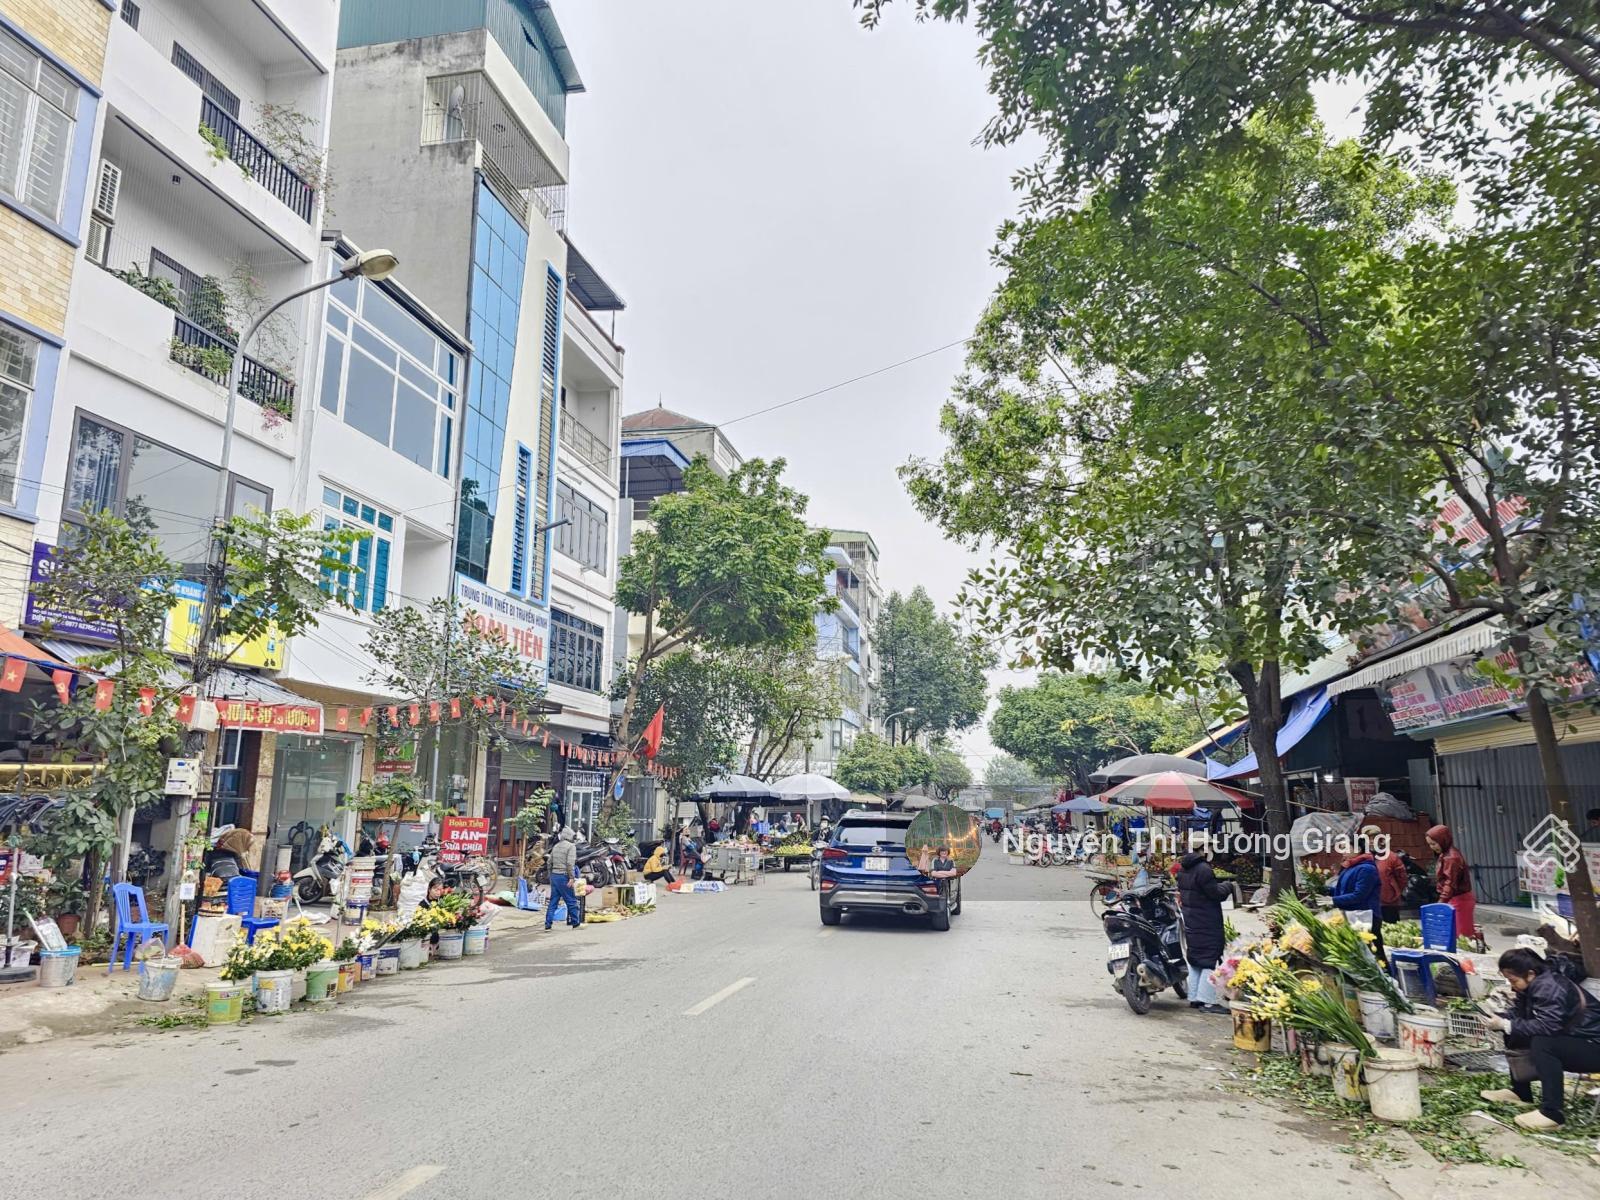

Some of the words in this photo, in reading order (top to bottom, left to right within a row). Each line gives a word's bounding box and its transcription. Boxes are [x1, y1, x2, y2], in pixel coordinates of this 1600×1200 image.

[461, 584, 480, 603] TRUNG
[512, 626, 543, 660] TIẾN
[451, 829, 479, 840] BÁN
